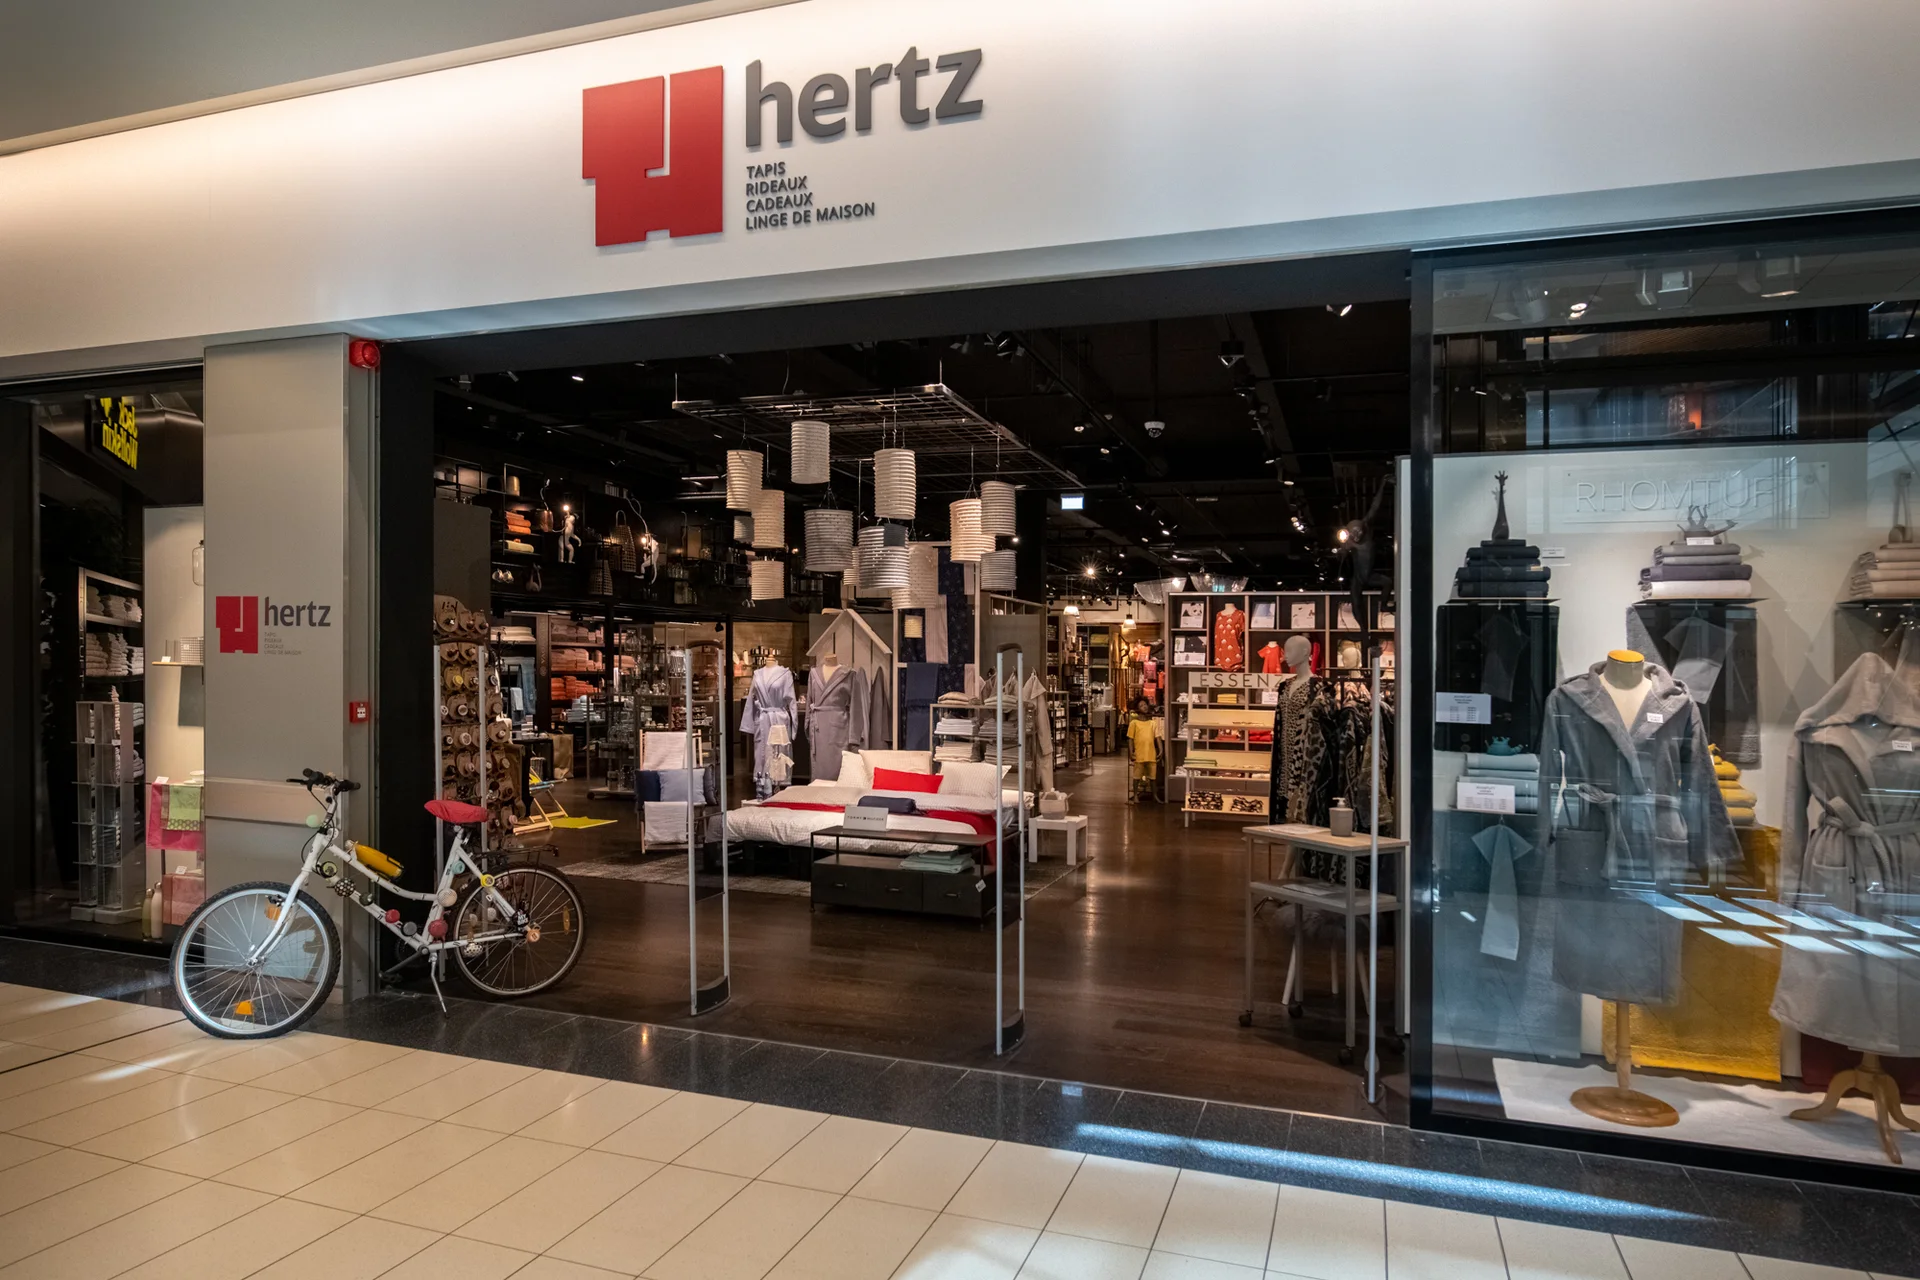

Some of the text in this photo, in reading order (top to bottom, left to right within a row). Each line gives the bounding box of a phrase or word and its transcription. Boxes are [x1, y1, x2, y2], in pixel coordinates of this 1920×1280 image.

[746, 46, 983, 147] hertz
[746, 161, 786, 179] TAPIS
[746, 175, 807, 196] RIDEAUX
[746, 192, 813, 213] CADEAUX
[746, 202, 875, 230] LINGE DE MAISON
[1576, 476, 1802, 513] RHOMTUFT
[264, 596, 331, 627] hertz
[1200, 673, 1283, 688] ESSENZ
